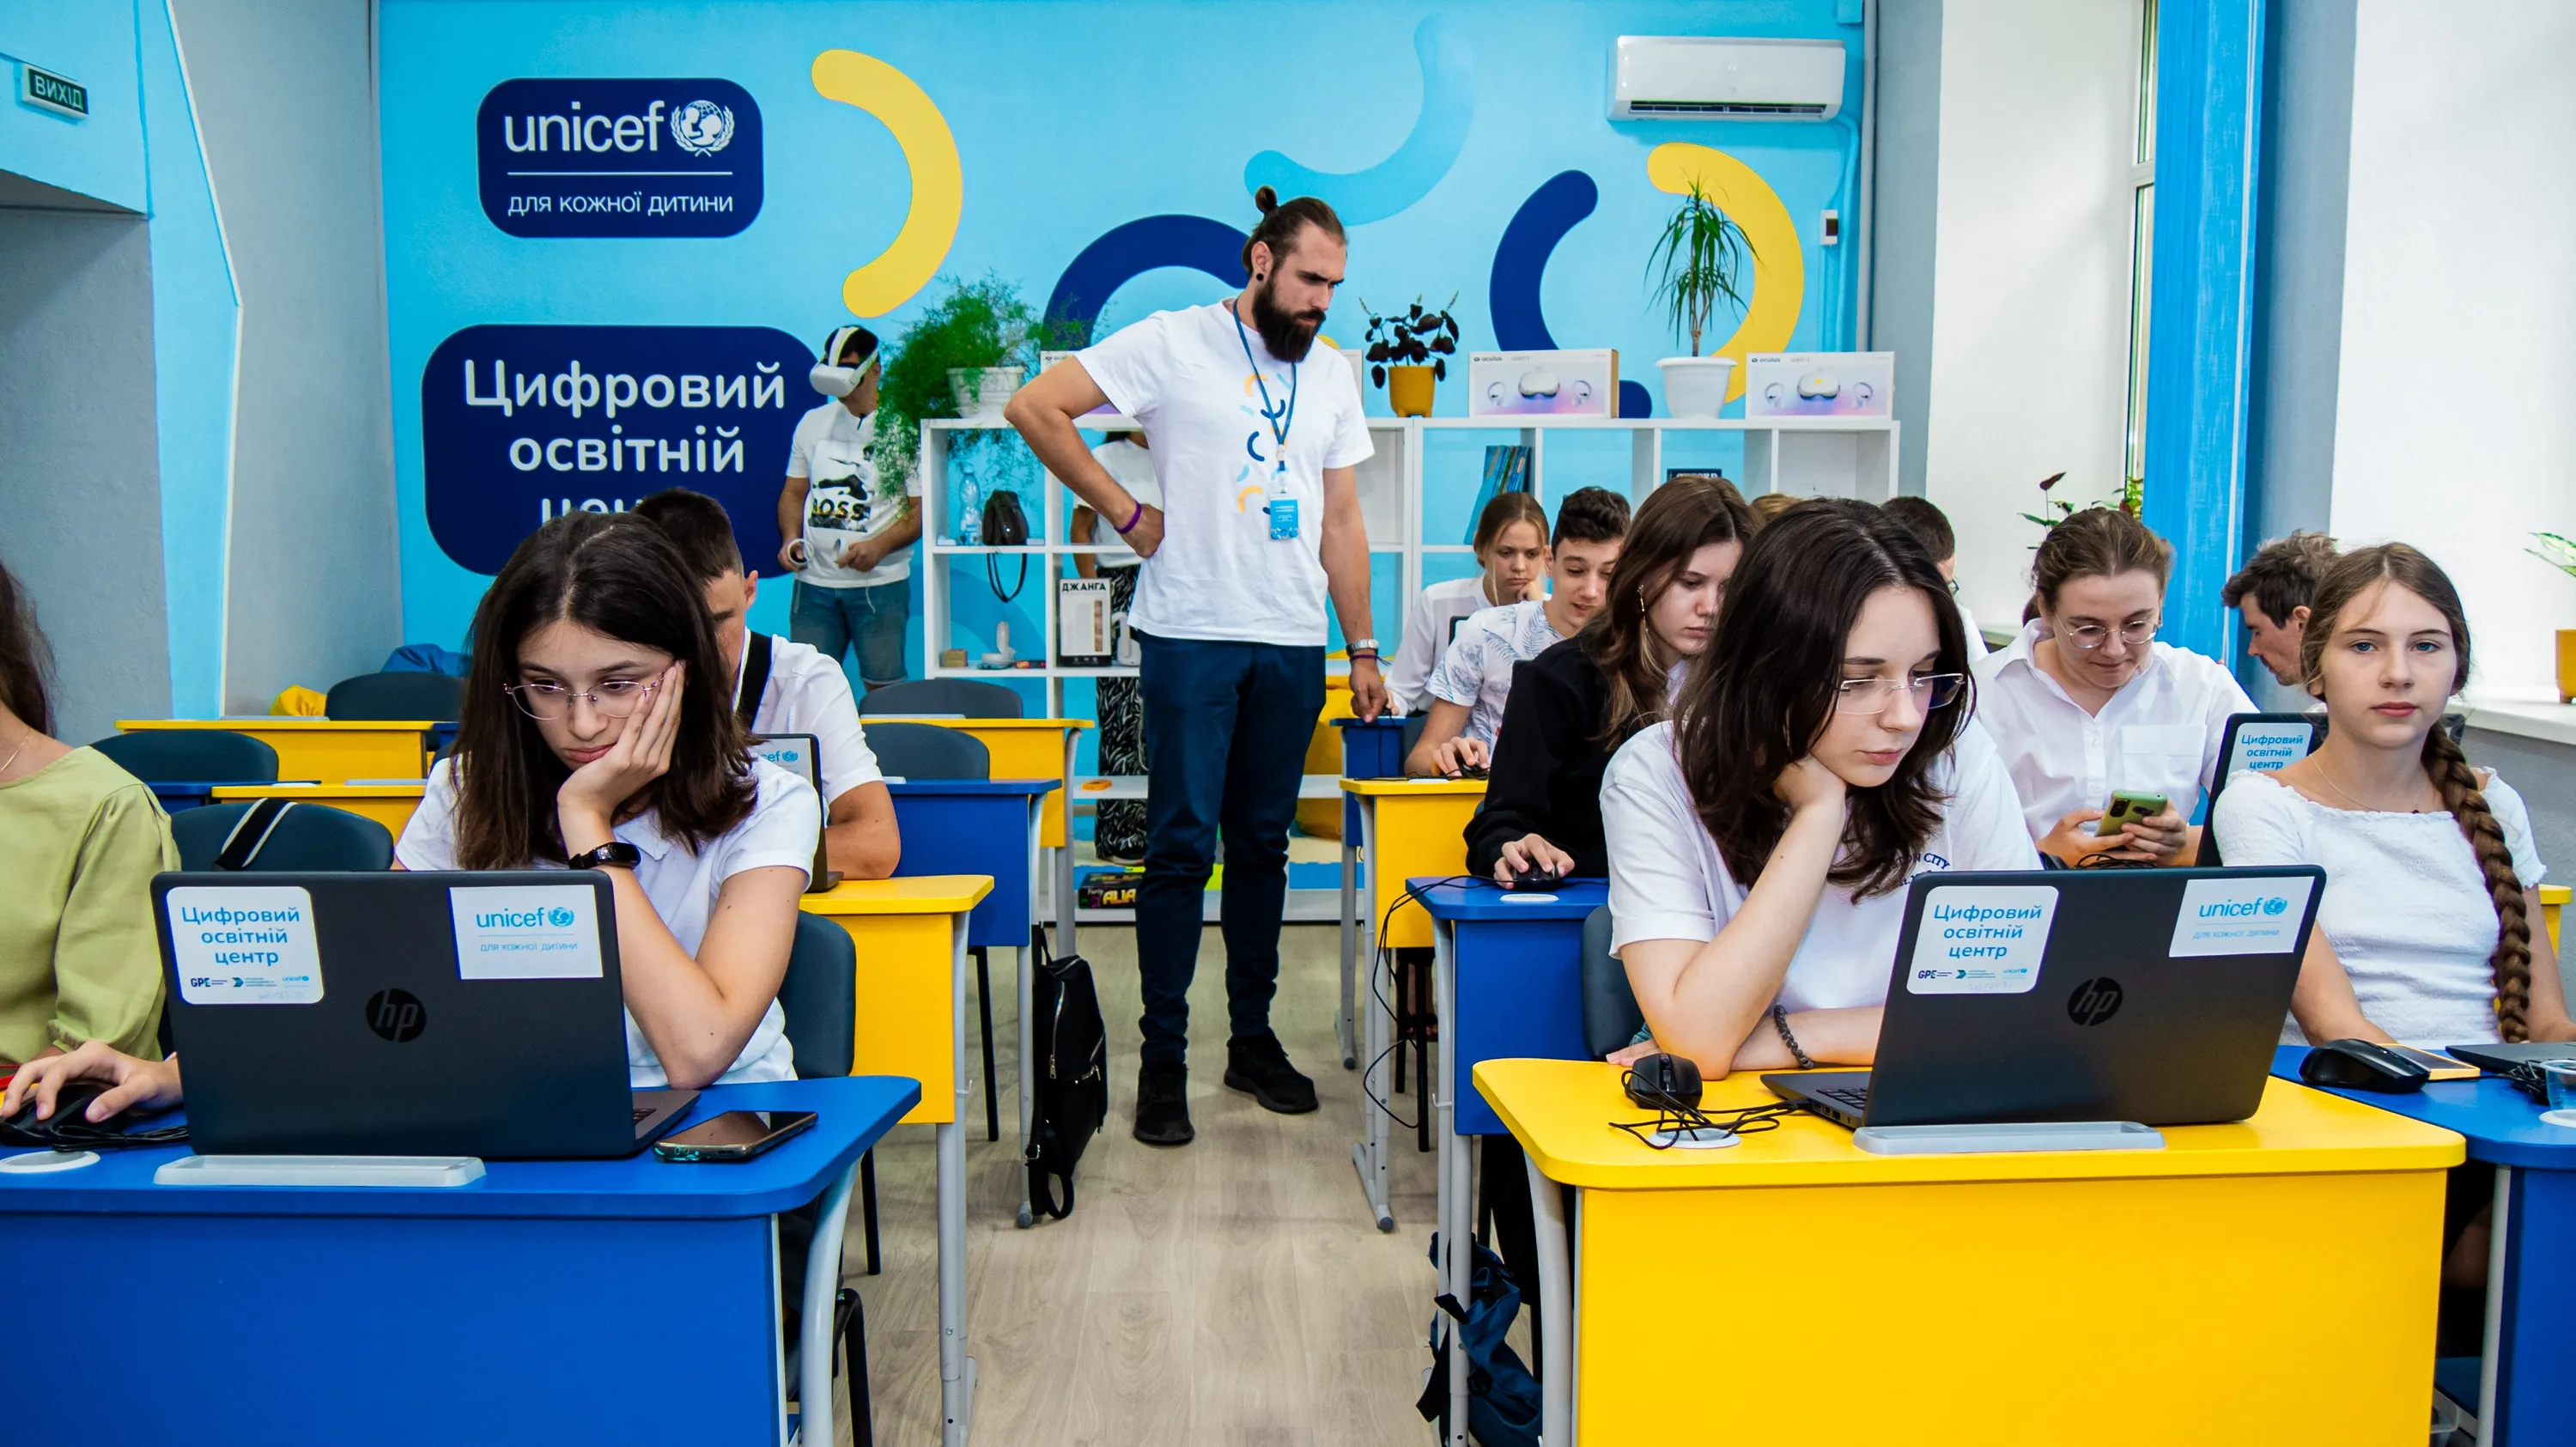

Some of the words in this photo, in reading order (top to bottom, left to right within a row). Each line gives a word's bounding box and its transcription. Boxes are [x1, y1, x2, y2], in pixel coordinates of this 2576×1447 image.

[34, 74, 83, 111] ВИХІД
[505, 100, 665, 152] unicef
[508, 196, 551, 216] для
[560, 192, 641, 212] кожної
[647, 196, 733, 216] дитини
[465, 359, 785, 418] Цифровий
[509, 424, 744, 472] освітній
[1061, 582, 1106, 592] ДЖАНГА
[2241, 735, 2304, 745] Цифровий
[2246, 747, 2293, 757] освітній
[2250, 762, 2284, 770] центр
[1923, 853, 1951, 870] CITY
[182, 907, 300, 925] Цифровий
[1934, 904, 2042, 922] Цифровий
[2198, 897, 2264, 918] unicef
[476, 907, 545, 927] unicef
[201, 927, 288, 944] освітній
[1943, 924, 2023, 939] освітній
[480, 943, 499, 951] для
[541, 943, 579, 951] дитини
[1948, 946, 2008, 960] центр
[215, 952, 279, 967] центр
[190, 977, 211, 988] GPE
[1917, 970, 1937, 979] GPE
[2073, 977, 2119, 1025] hp
[375, 989, 419, 1042] hp
